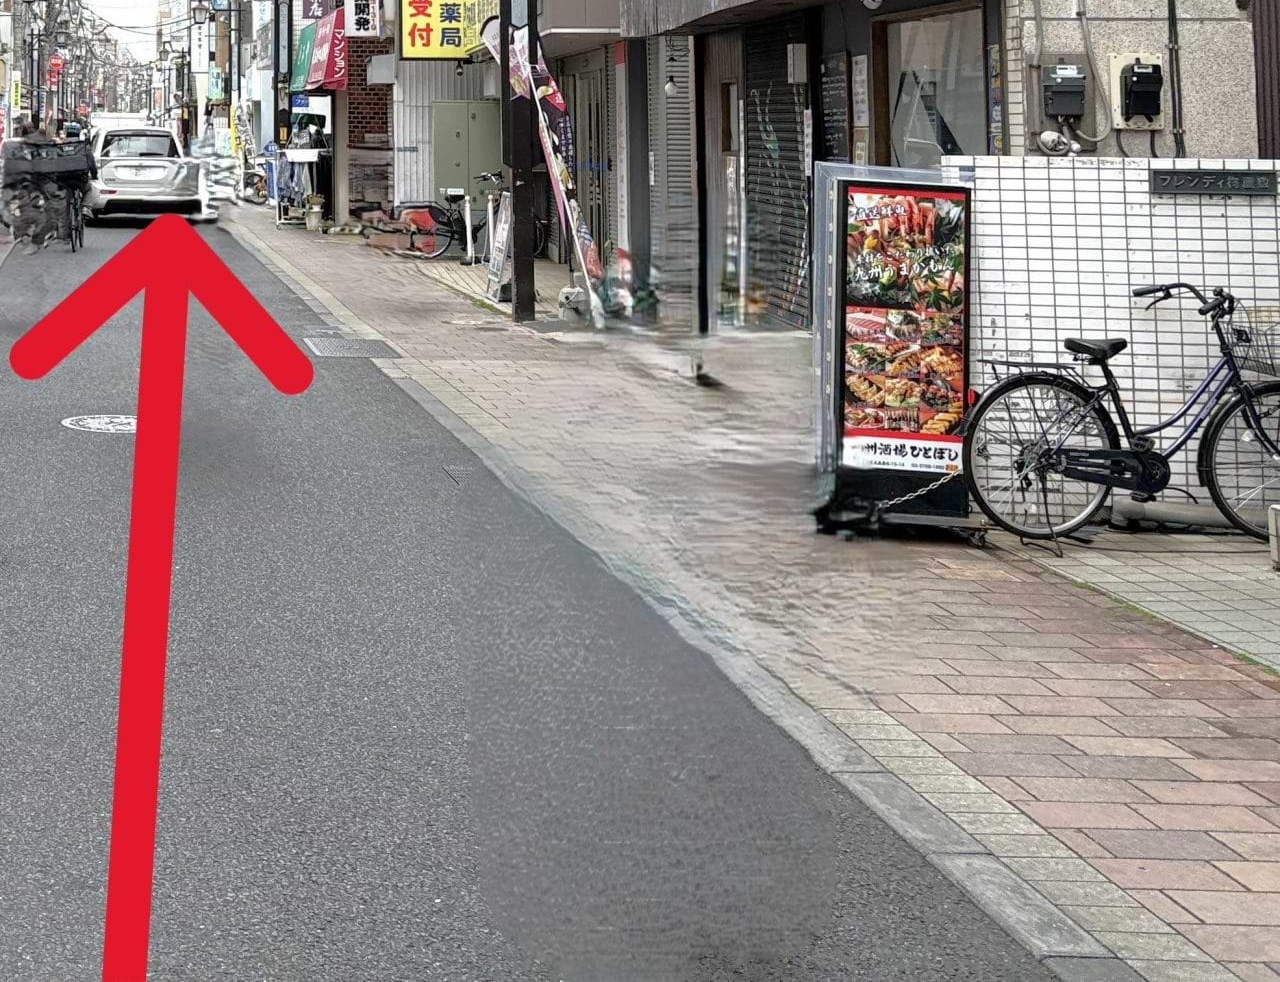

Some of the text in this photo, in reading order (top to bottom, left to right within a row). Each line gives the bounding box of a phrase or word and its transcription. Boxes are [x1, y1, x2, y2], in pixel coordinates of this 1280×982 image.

[334, 29, 345, 78] マンション
[850, 442, 959, 461] 州酒場ひとぼし
